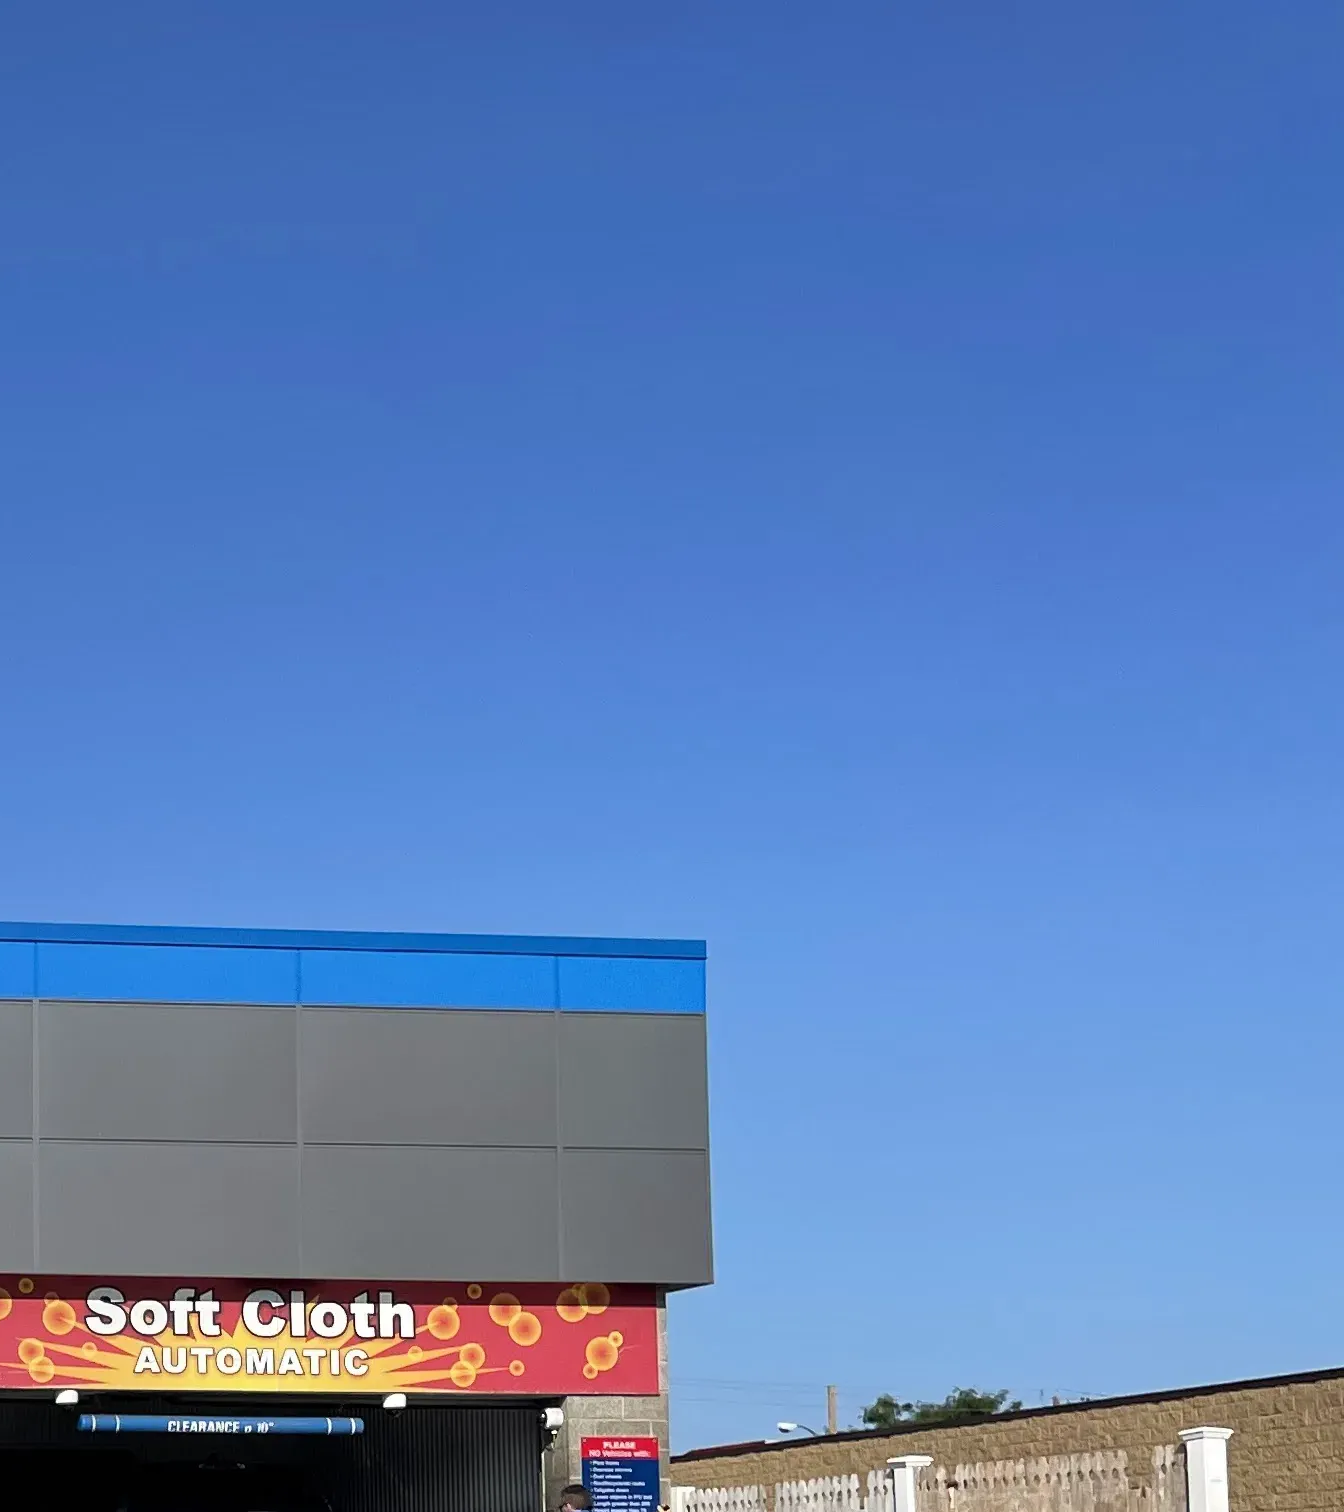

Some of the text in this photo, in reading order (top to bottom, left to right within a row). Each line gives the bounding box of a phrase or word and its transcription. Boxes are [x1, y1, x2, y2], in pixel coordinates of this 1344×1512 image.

[84, 1286, 416, 1339] Soft Cloth
[133, 1345, 370, 1377] AUTOMATIC
[167, 1420, 240, 1434] CLEARANCE
[602, 1441, 637, 1450] PLEASE
[588, 1449, 602, 1458] NO
